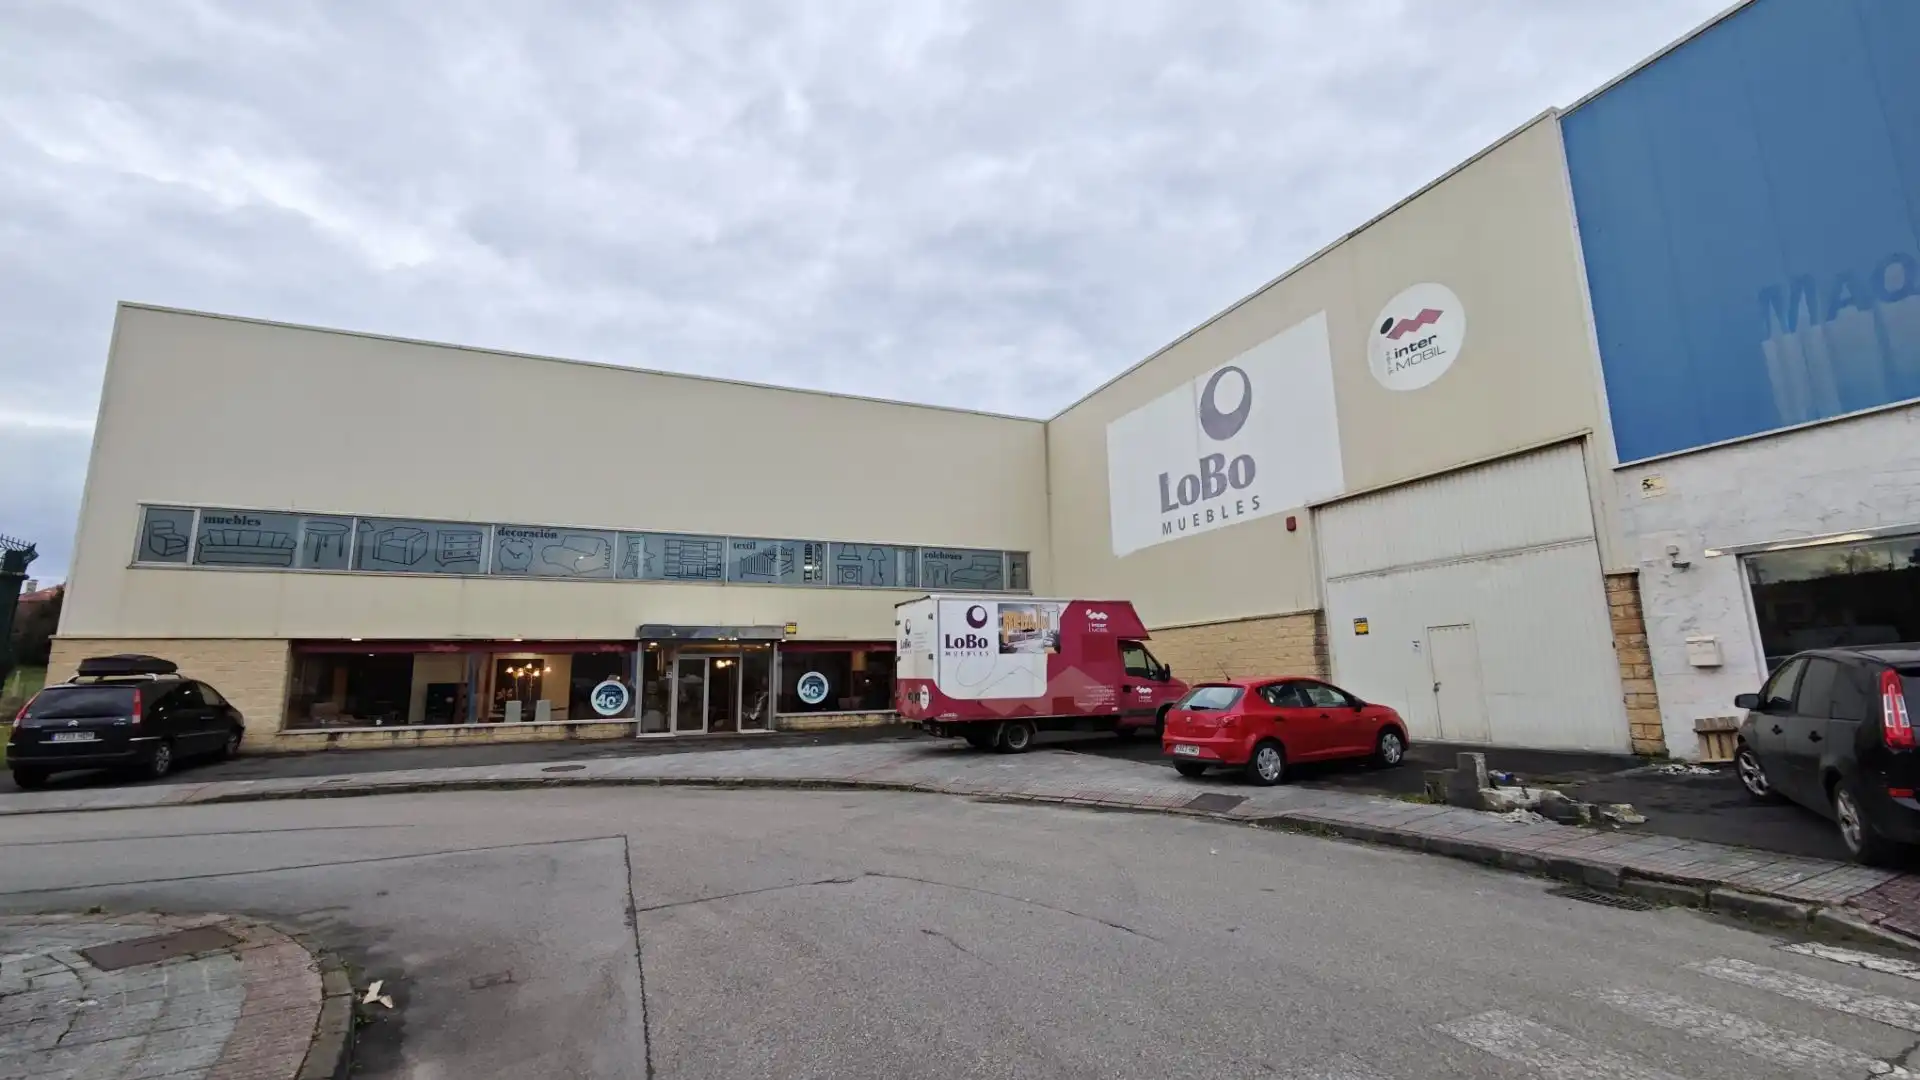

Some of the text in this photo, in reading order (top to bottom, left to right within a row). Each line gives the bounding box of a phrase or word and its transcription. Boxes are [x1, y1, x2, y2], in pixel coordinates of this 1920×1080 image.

[1394, 334, 1437, 359] inter
[1396, 345, 1446, 371] MOBIL
[1158, 452, 1256, 514] LoBo
[203, 515, 262, 526] muebles
[1162, 495, 1260, 536] MUEBLES
[497, 527, 557, 538] decoración
[733, 541, 756, 550] textil
[944, 634, 989, 649] LoBo
